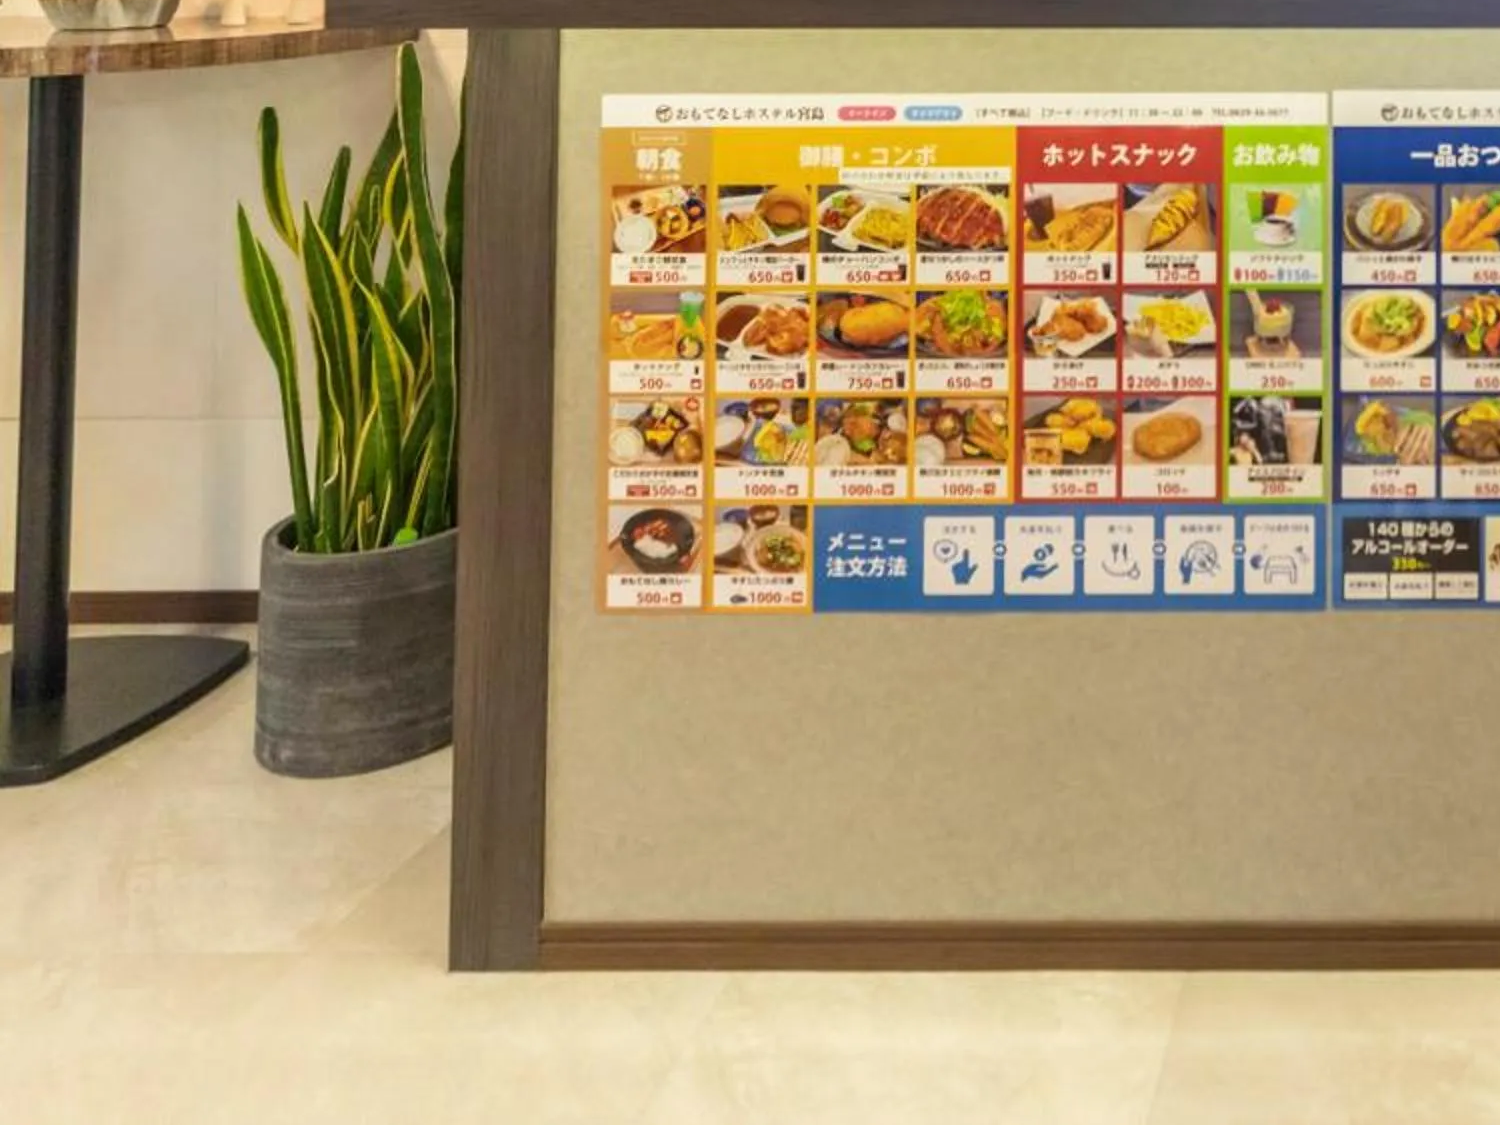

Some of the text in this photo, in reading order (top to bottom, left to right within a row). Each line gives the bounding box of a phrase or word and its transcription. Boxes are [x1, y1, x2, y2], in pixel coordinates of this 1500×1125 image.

[1043, 143, 1198, 167] ホットスナック
[1232, 143, 1322, 167] お飲み物
[827, 532, 908, 551] メニュー
[826, 556, 908, 578] 注文方法
